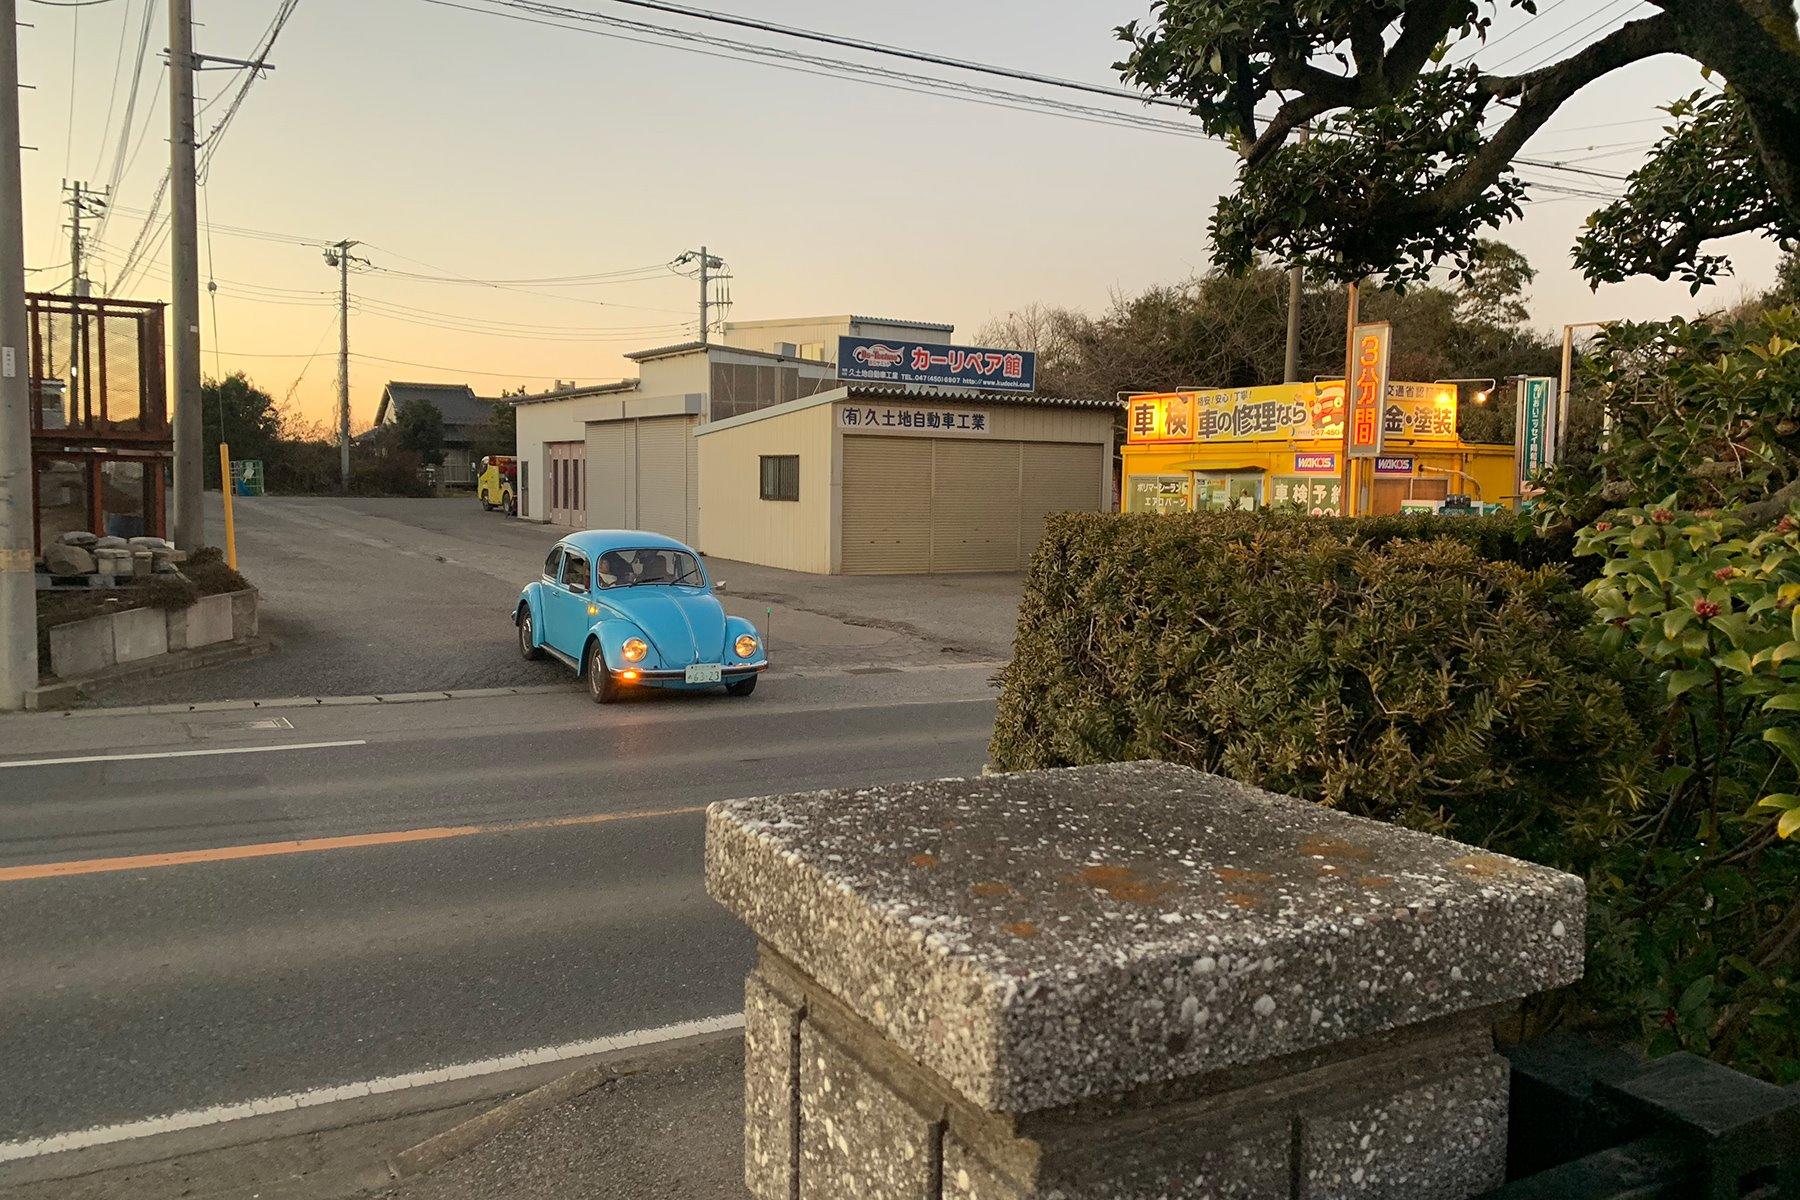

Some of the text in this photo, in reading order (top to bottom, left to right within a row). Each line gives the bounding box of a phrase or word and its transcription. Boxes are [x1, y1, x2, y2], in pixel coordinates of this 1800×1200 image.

[911, 347, 1022, 378] カーリペア館
[1134, 402, 1188, 436] 車検
[1198, 401, 1307, 439] 車の修理なら
